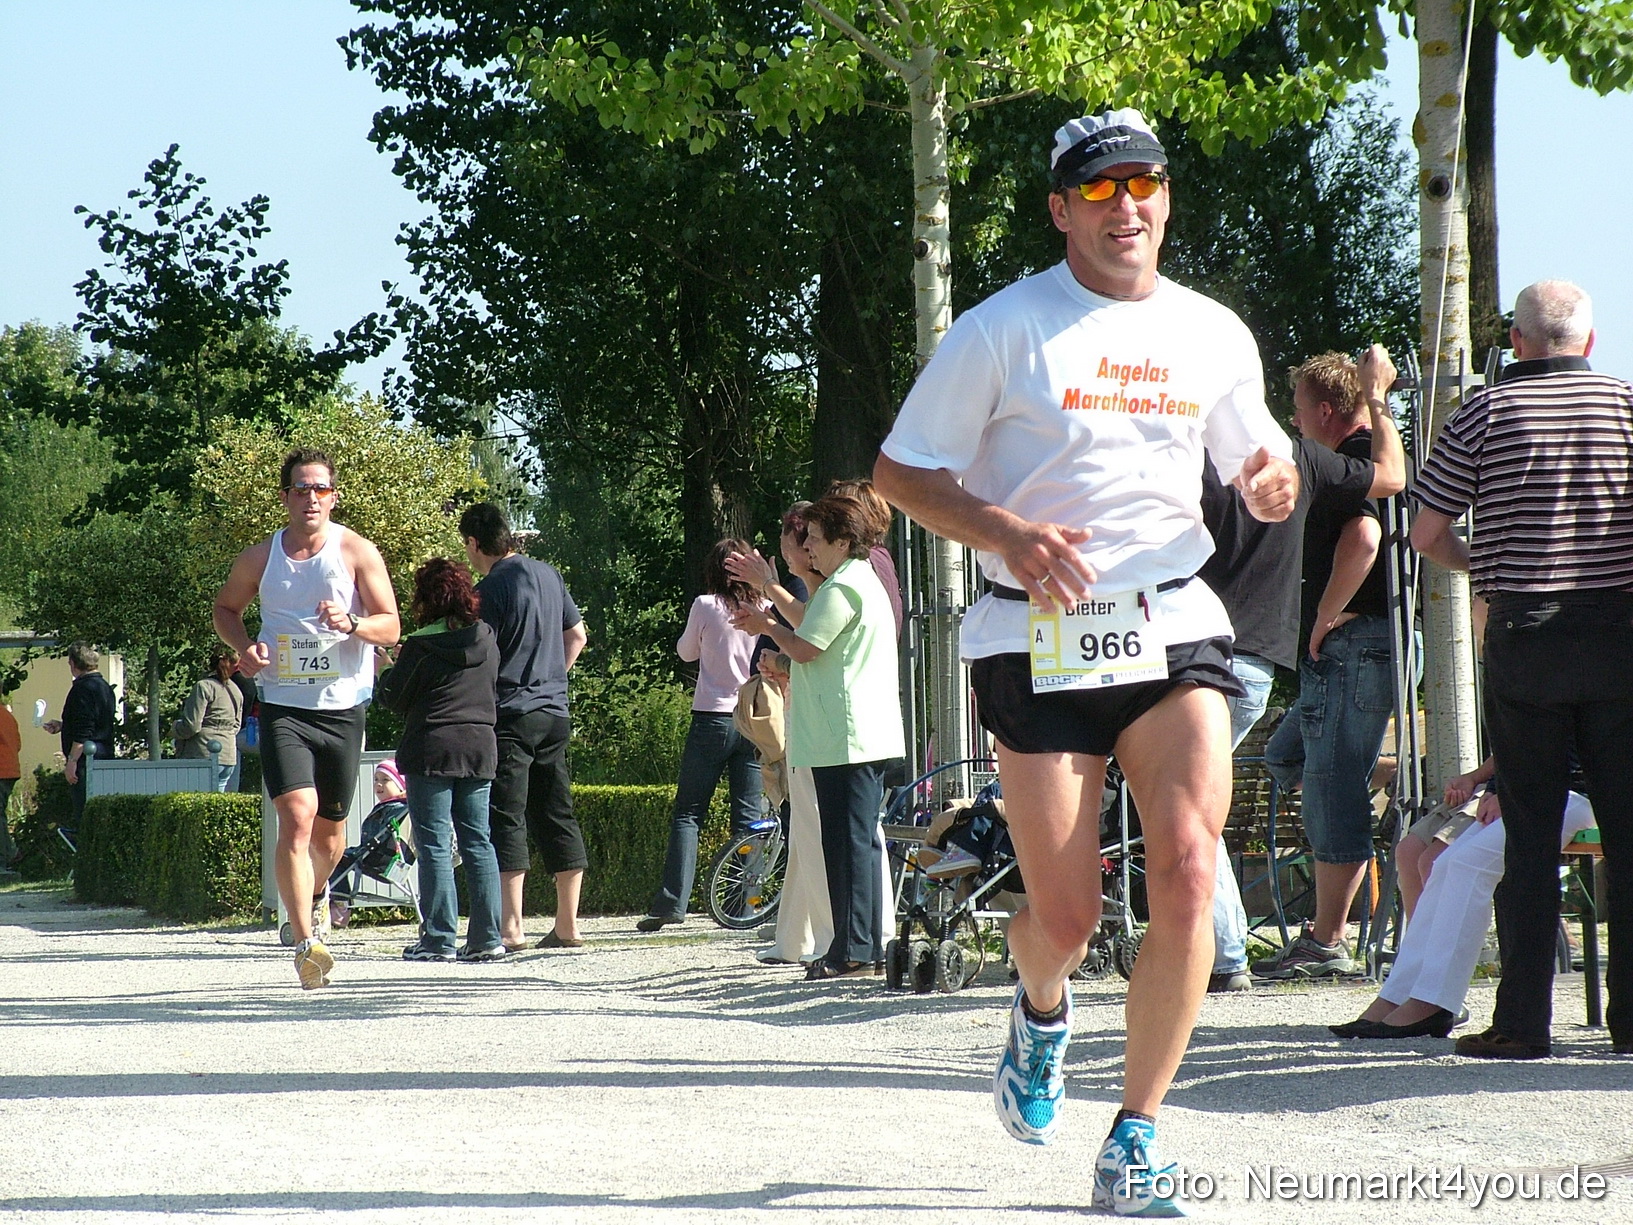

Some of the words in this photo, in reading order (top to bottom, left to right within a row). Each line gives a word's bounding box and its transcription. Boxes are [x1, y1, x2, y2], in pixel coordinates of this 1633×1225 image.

[1097, 357, 1169, 387] Angelas
[1062, 388, 1200, 418] Marathon-Team
[292, 639, 318, 649] Stefan
[1035, 629, 1043, 643] A
[1080, 631, 1142, 661] 966
[299, 656, 330, 671] 743
